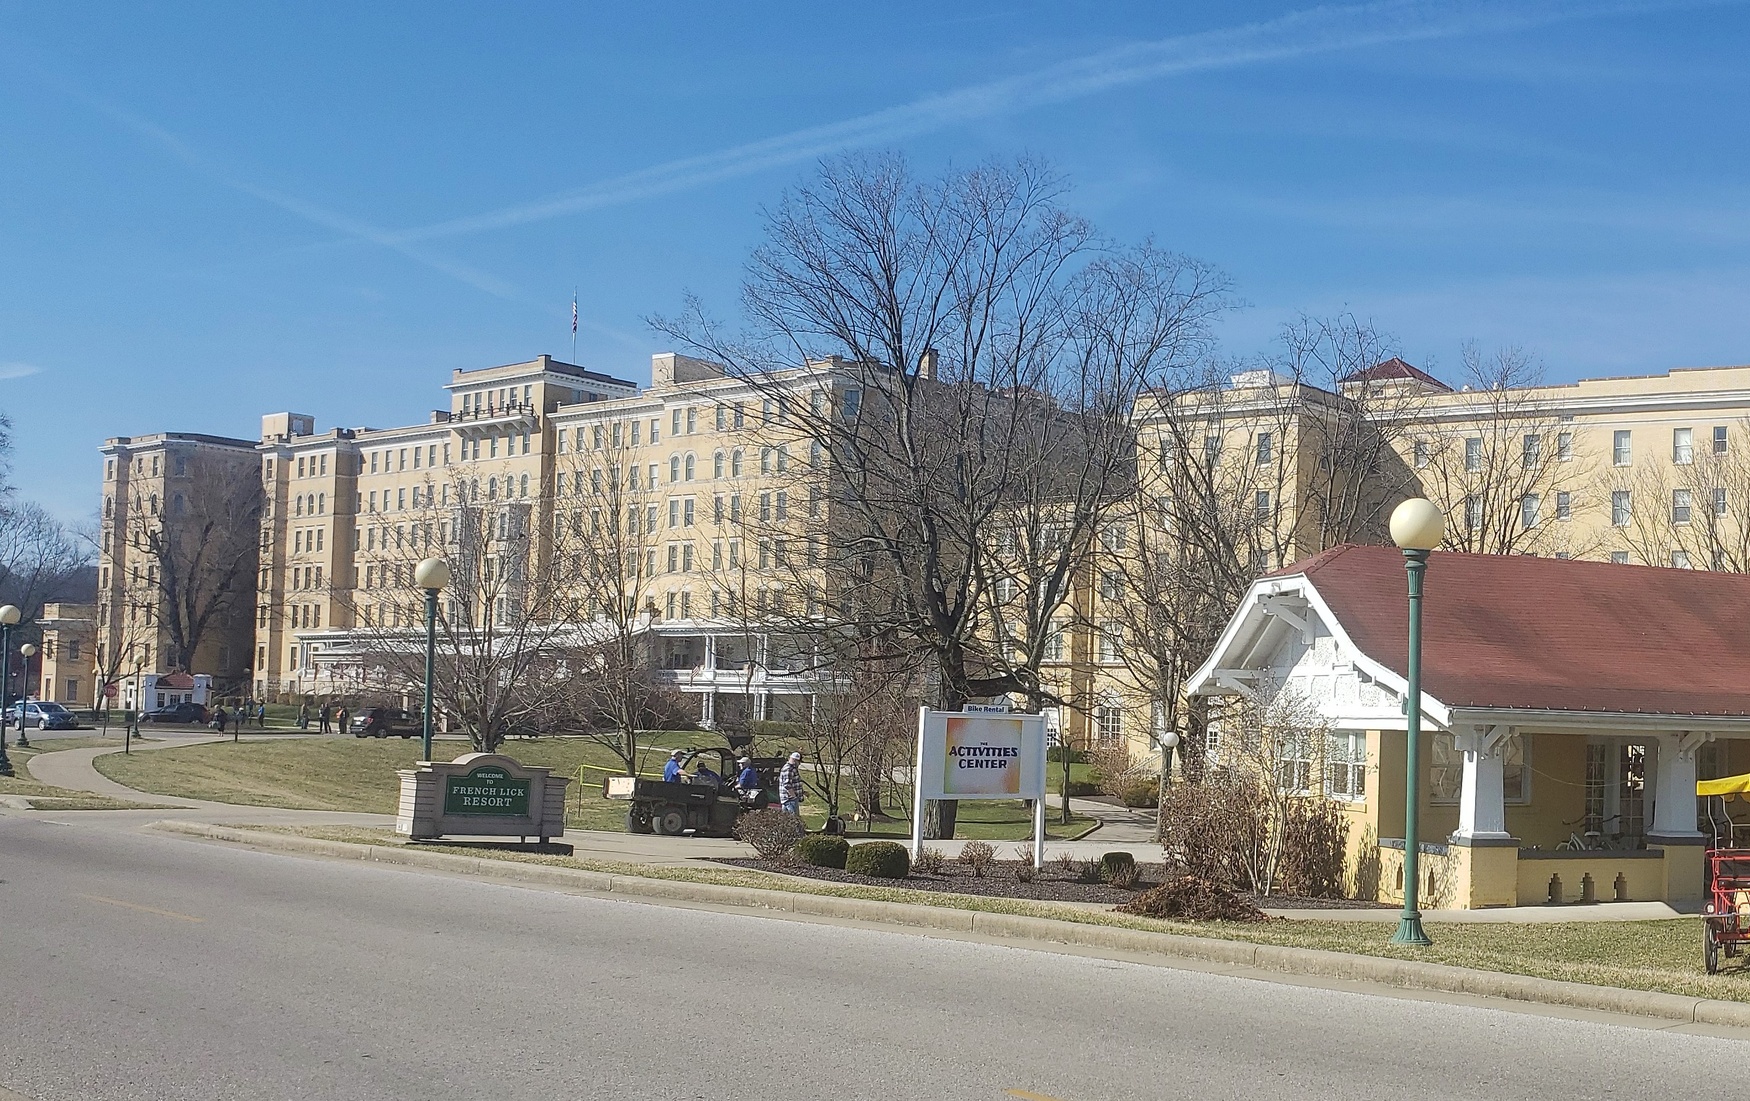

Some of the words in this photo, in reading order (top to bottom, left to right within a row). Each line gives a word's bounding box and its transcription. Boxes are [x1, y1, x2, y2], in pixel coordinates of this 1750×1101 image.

[948, 745, 1018, 757] ACTIVITIES
[958, 758, 1008, 769] CENTER
[452, 786, 497, 795] FRENCH
[499, 788, 525, 797] LICK
[463, 796, 513, 807] RESORT
